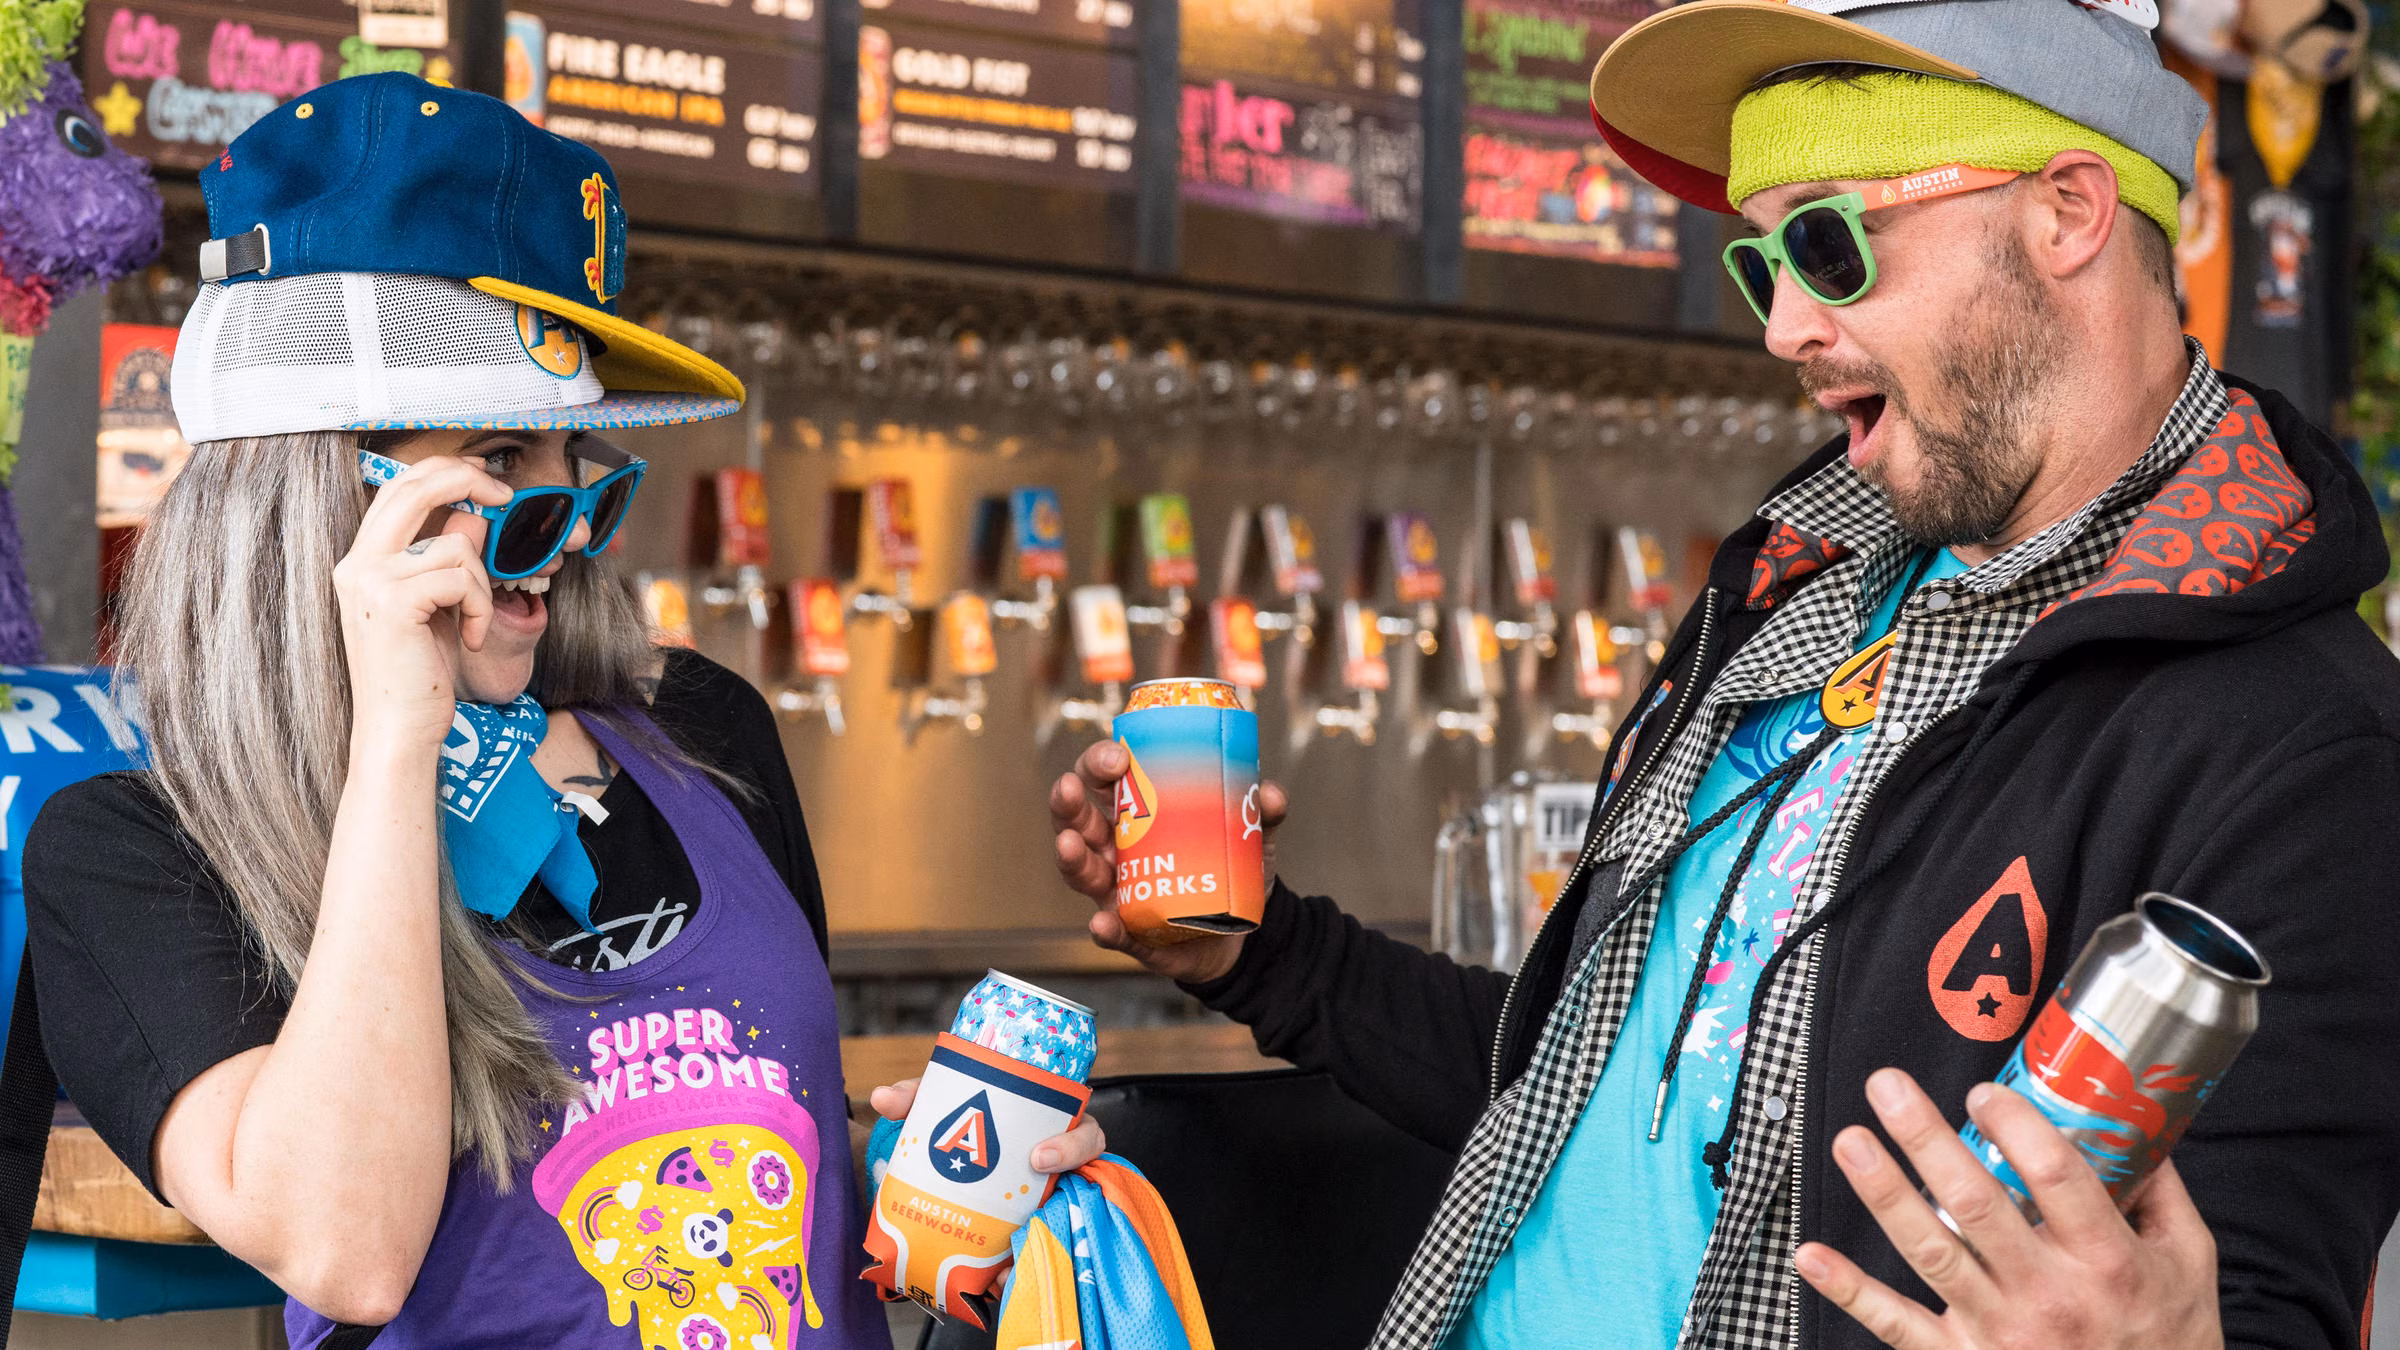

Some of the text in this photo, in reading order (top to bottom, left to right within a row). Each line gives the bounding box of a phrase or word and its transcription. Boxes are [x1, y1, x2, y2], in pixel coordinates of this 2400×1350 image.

[624, 44, 726, 95] EAGLE
[1902, 168, 1960, 192] AUSTIN
[1117, 853, 1175, 883] STIN
[1117, 873, 1217, 906] WORKS
[1941, 893, 2032, 996] A
[587, 1007, 736, 1070] SUPER
[562, 1052, 788, 1138] AWESOME
[934, 1106, 988, 1168] A
[891, 1200, 987, 1246] BEERWORKS
[909, 1196, 972, 1228] AUSTIN
